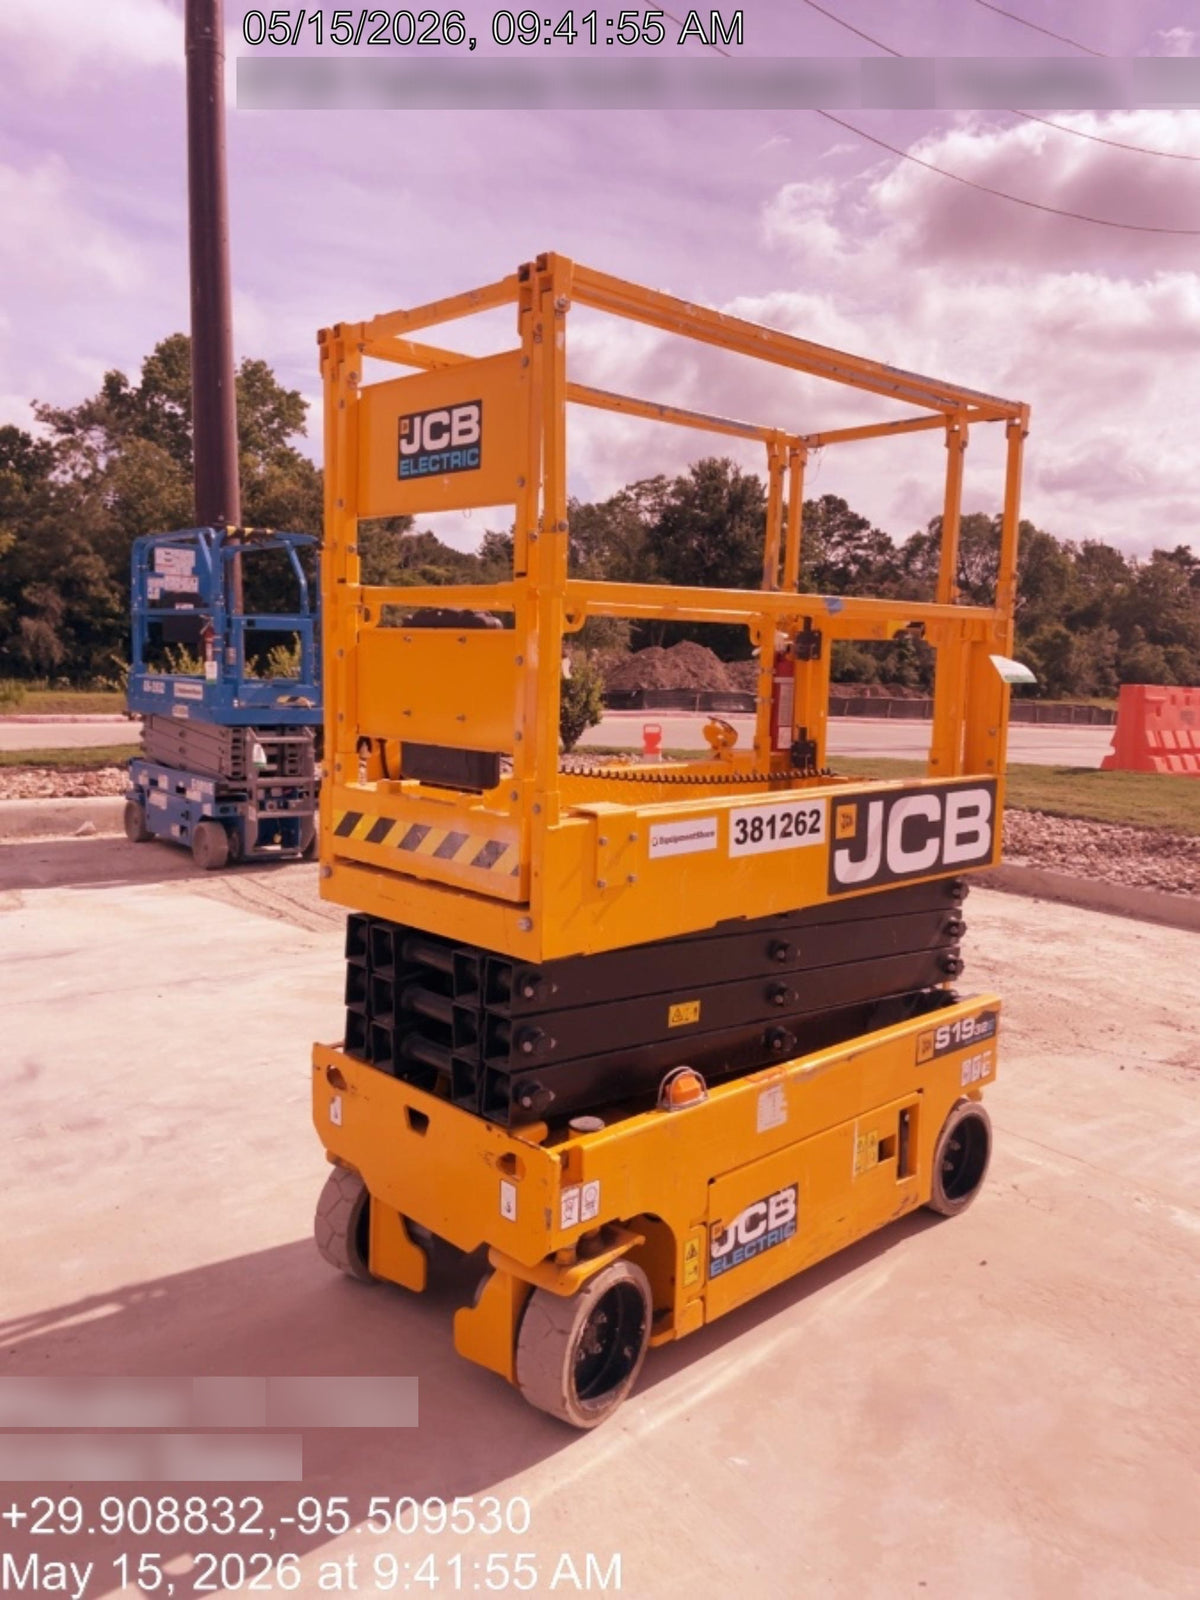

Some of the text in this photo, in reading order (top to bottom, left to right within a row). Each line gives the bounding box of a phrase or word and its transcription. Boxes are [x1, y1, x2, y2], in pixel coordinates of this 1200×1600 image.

[400, 404, 481, 455] JCB
[400, 447, 480, 476] ELECTRIC
[734, 808, 821, 845] 381262
[833, 788, 993, 884] JCB
[710, 1187, 797, 1259] JCB
[710, 1221, 796, 1278] ELECTRIC
